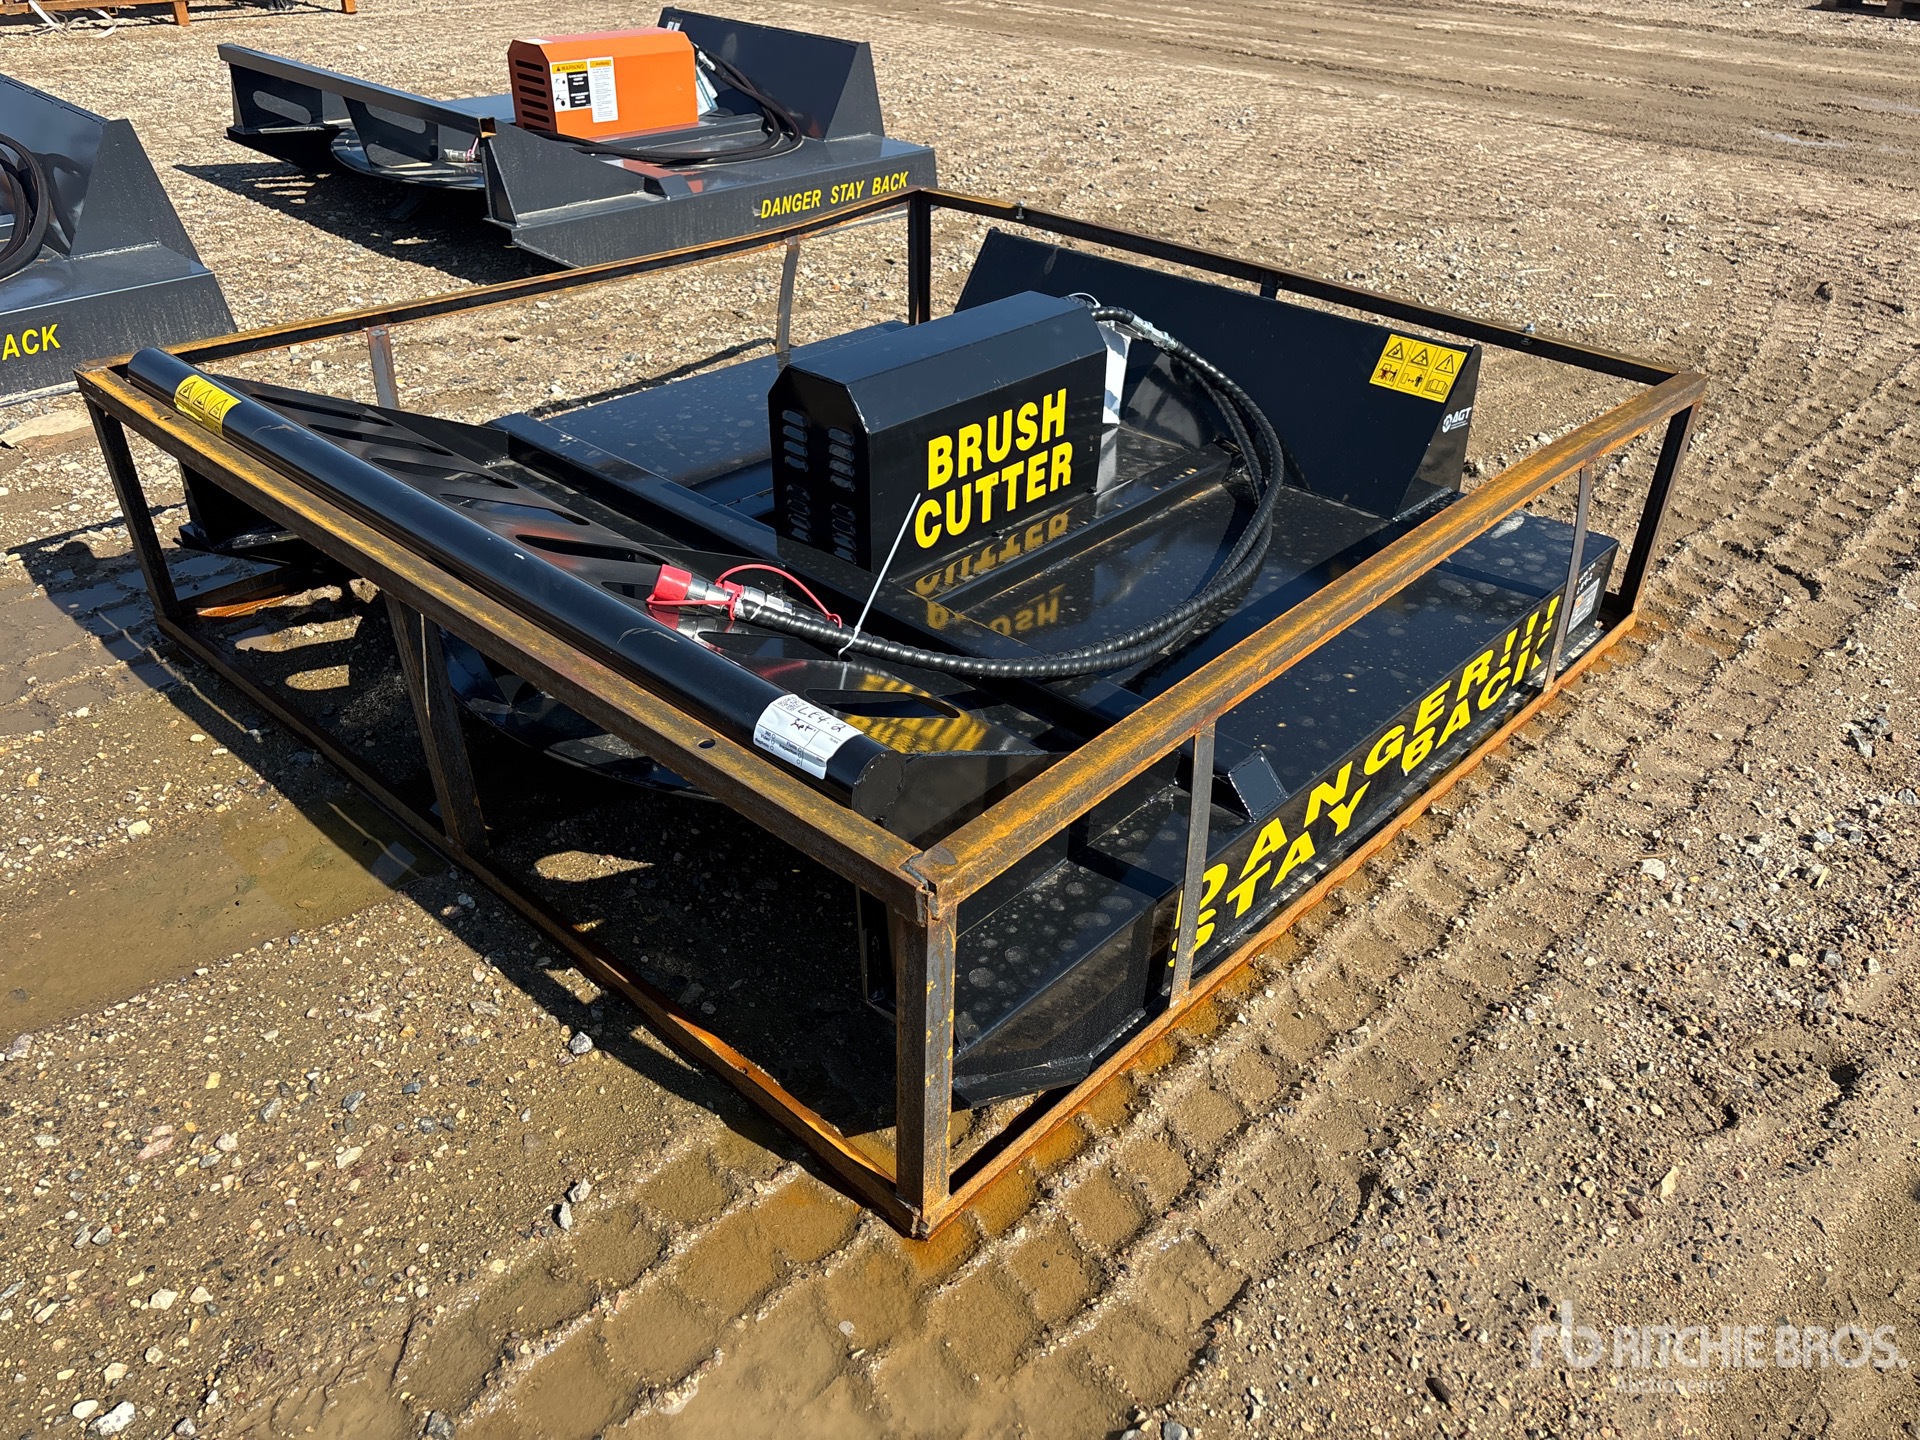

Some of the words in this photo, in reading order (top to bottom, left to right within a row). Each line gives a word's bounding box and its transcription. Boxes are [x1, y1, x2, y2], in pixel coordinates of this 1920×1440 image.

[760, 189, 822, 219] DANGER
[830, 180, 865, 205] STAY
[871, 171, 909, 196] BACK
[928, 388, 1067, 491] BRUSH
[1451, 407, 1473, 424] AGT
[914, 441, 1074, 549] CUTTER
[1401, 631, 1550, 776] BACK
